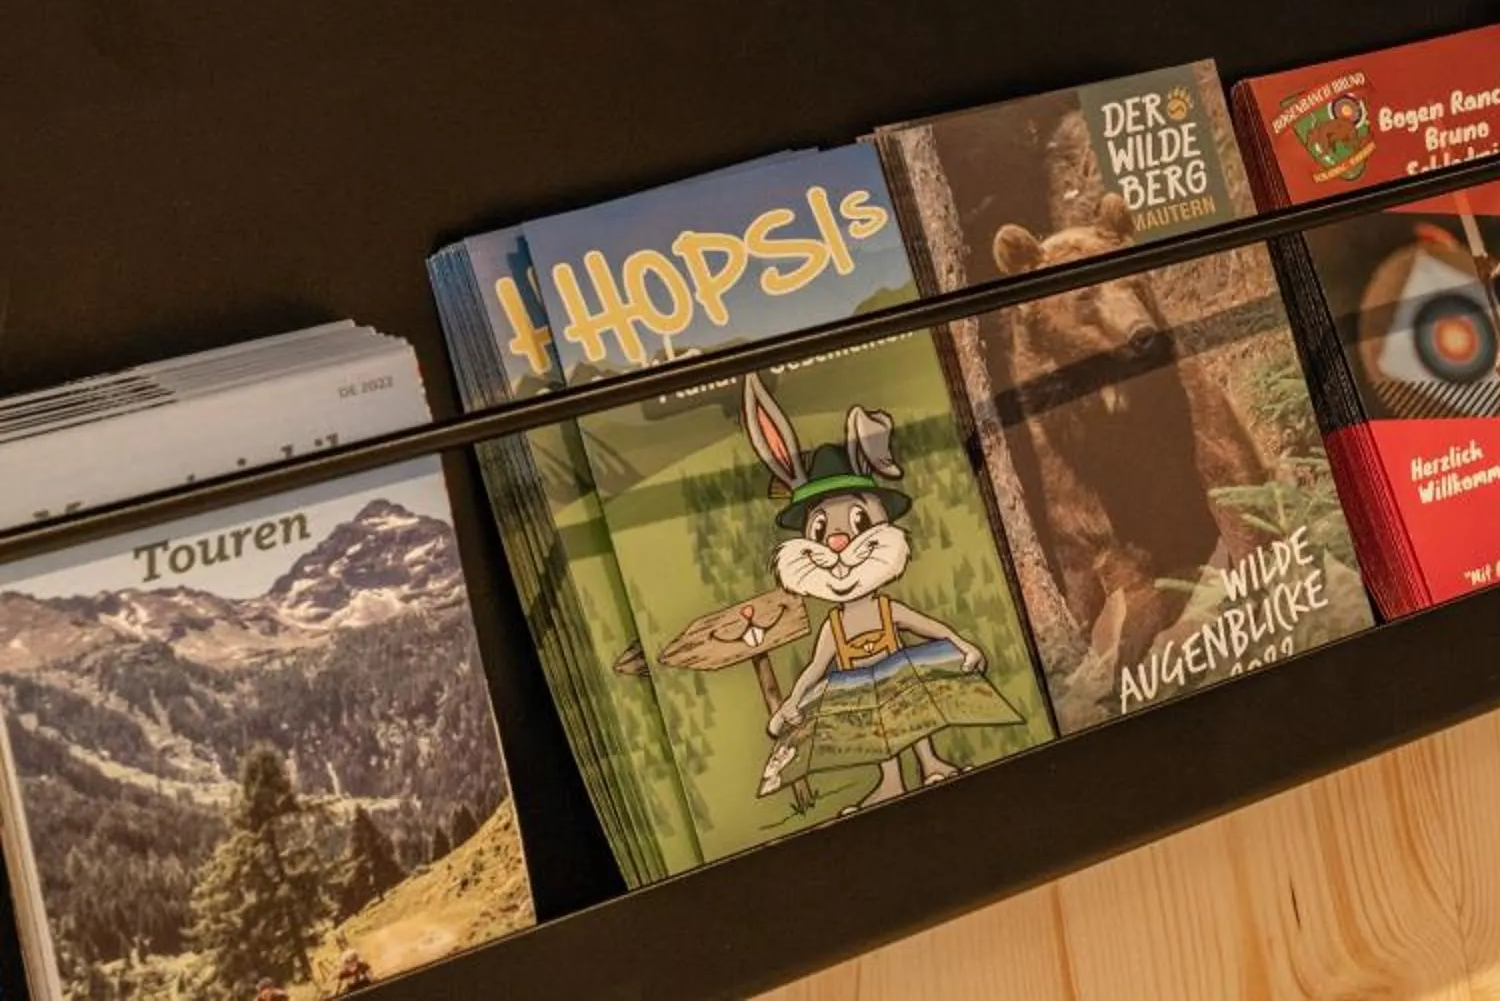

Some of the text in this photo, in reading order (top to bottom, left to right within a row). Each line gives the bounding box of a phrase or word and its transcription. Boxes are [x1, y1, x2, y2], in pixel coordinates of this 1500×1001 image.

[1101, 93, 1165, 139] DER
[1378, 102, 1445, 132] Bogen
[1425, 121, 1490, 152] Bruno
[1107, 121, 1201, 176] WILDE
[1118, 159, 1208, 212] BERG
[1410, 439, 1485, 481] Herzlich
[133, 511, 311, 584] Touren
[1220, 525, 1315, 602] WILDE
[1119, 569, 1329, 715] AUGENBLICKE
